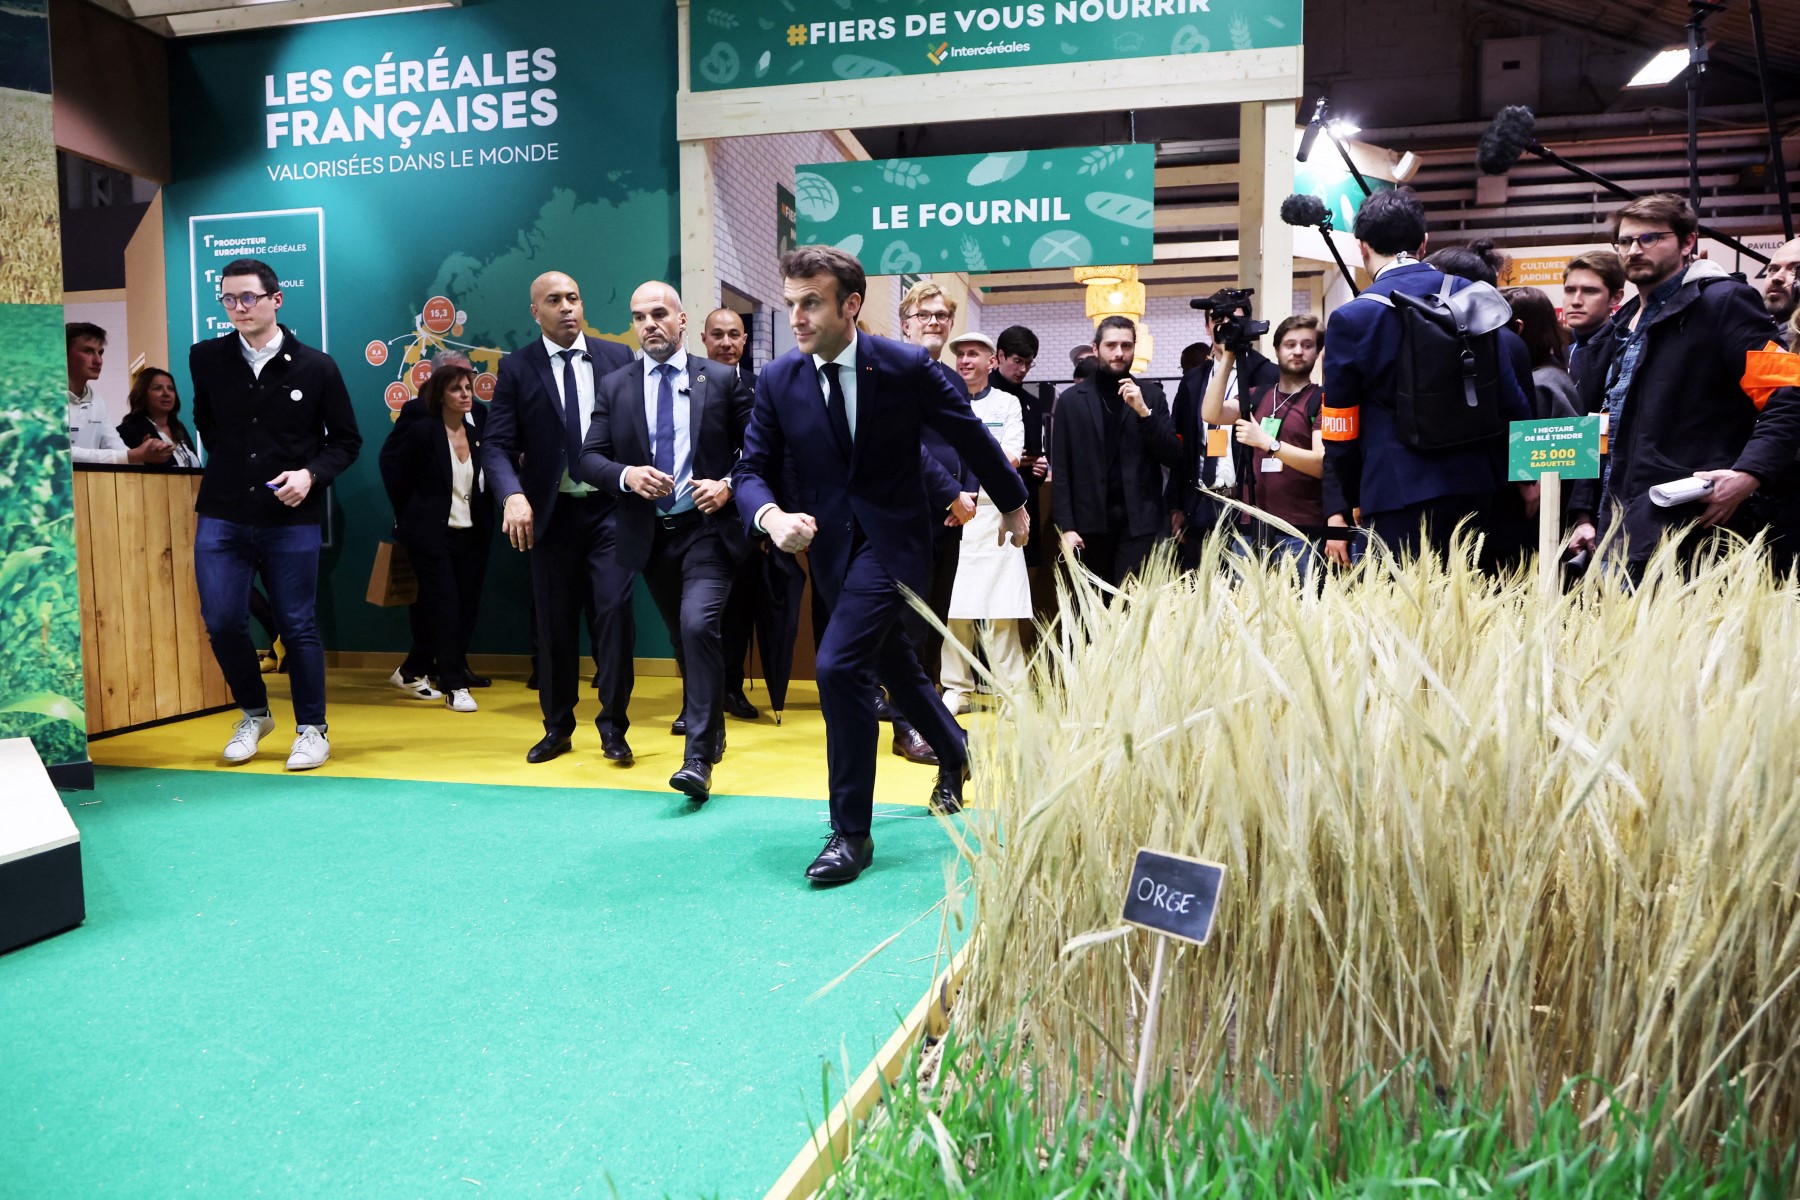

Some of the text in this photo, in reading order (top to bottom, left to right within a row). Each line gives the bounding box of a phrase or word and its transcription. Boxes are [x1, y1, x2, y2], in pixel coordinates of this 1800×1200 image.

[786, 0, 1210, 46] #FIERS DE VOUS NOURRIR
[951, 41, 1031, 57] Intercéréales
[265, 46, 557, 107] LES CÉRÉALES
[266, 88, 558, 150] FRANÇAISES
[267, 142, 559, 182] VALORISÉES DANS LE MONDE
[872, 196, 1071, 230] LE FOURNIL
[214, 237, 266, 247] PRODUCTEUR
[1748, 242, 1784, 250] PAVILLO
[214, 243, 307, 257] EUROPÉEN DE CÉRÉALES
[278, 279, 305, 288] MOULE
[1520, 273, 1551, 283] JARDIN
[430, 308, 448, 319] 15,3
[1324, 416, 1353, 432] POOL 1
[1538, 426, 1574, 434] HECTARE
[1536, 433, 1550, 441] BLÉ
[1531, 448, 1576, 460] 25 000
[1137, 877, 1195, 914] ORGE
